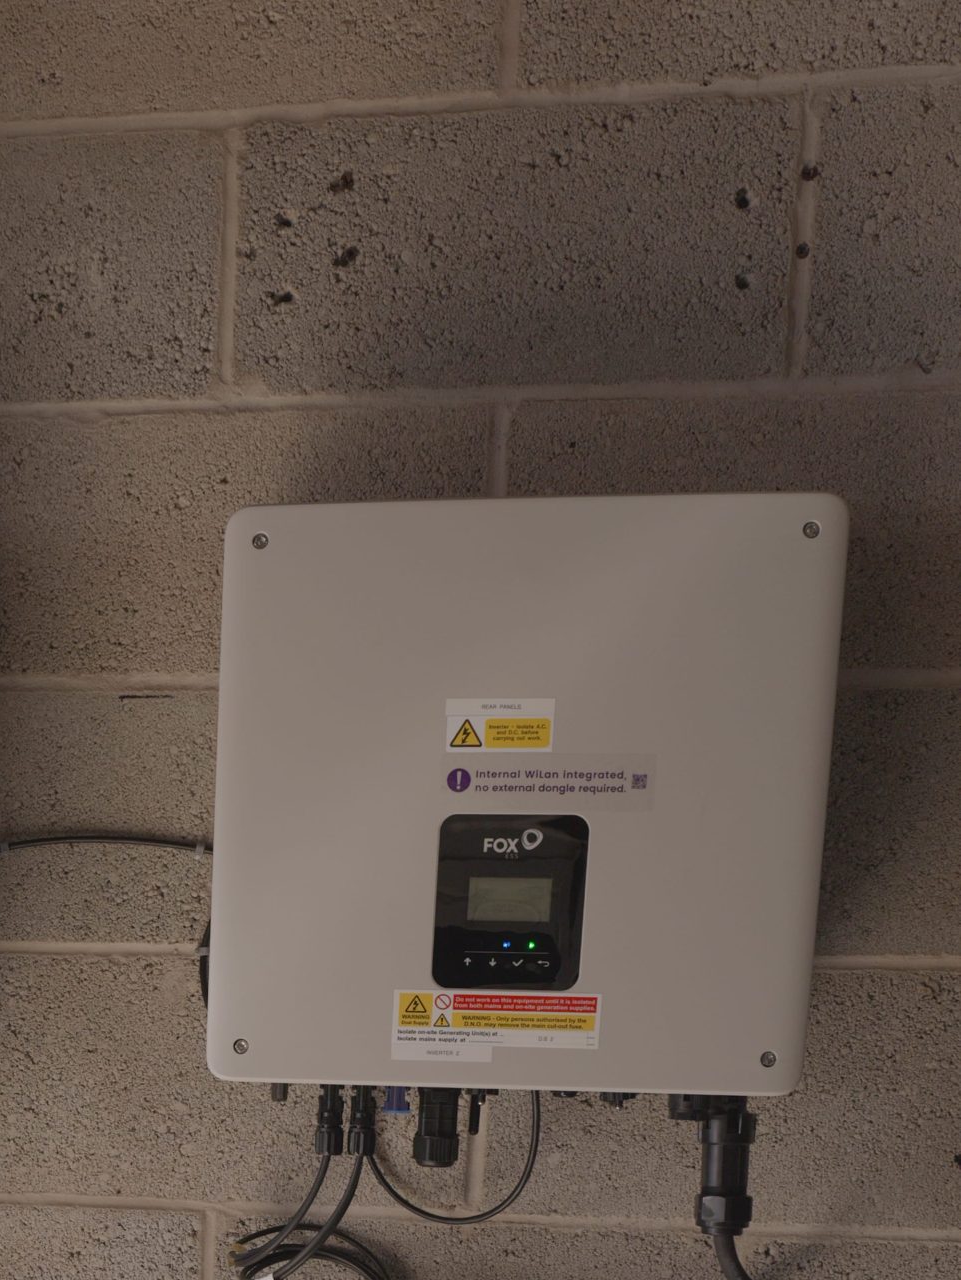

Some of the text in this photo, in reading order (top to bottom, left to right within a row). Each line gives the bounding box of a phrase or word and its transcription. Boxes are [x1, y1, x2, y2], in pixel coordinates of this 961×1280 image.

[563, 770, 626, 781] integrated,
[492, 784, 535, 792] external
[539, 784, 575, 794] dongle
[578, 784, 626, 795] required.
[483, 838, 519, 852] FOX
